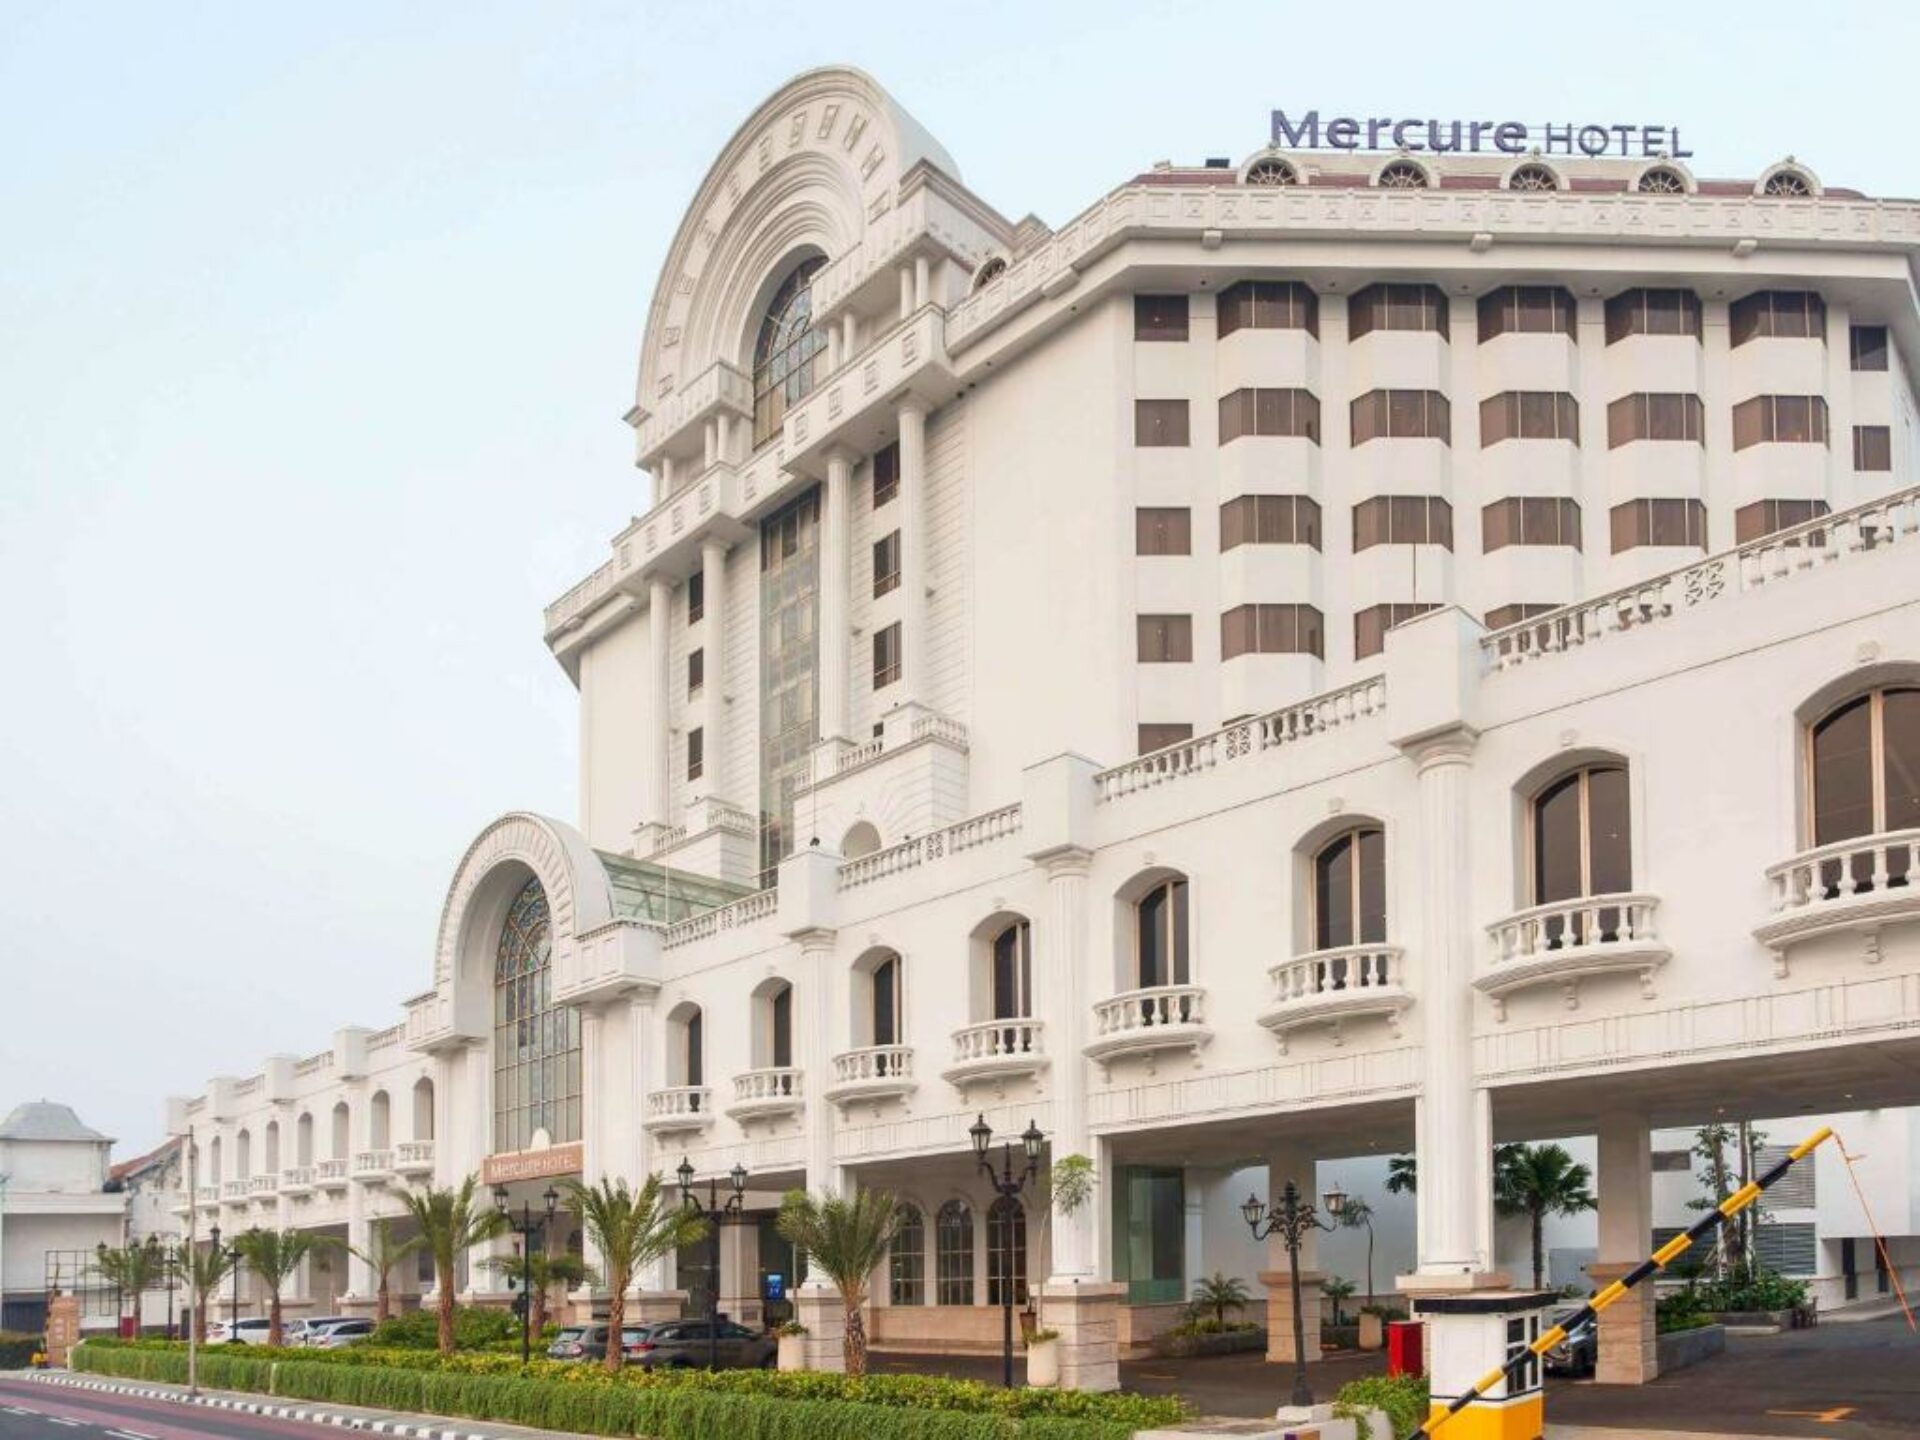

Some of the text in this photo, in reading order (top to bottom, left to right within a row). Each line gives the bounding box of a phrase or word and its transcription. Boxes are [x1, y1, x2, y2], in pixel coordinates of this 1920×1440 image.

[1271, 109, 1694, 158] Mercure HOTEL
[490, 1161, 541, 1178] Mercure
